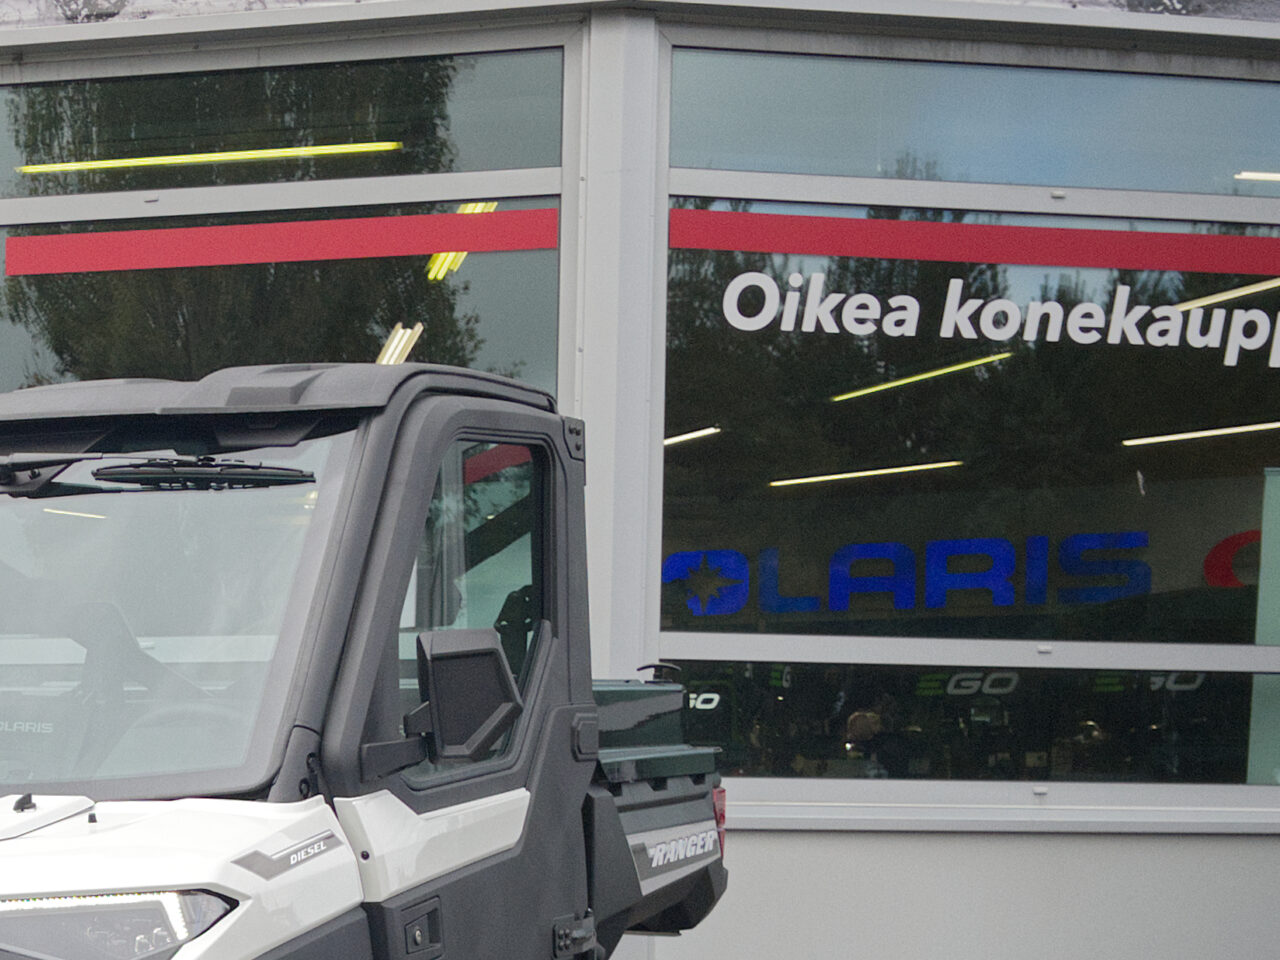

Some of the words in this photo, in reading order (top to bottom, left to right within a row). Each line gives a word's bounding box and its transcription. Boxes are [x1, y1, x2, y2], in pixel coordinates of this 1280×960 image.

[722, 272, 920, 337] Oikea
[940, 278, 1280, 367] konekaup
[915, 672, 1019, 696] EGO
[290, 841, 327, 865] DIESEL
[648, 830, 718, 868] RANGER
